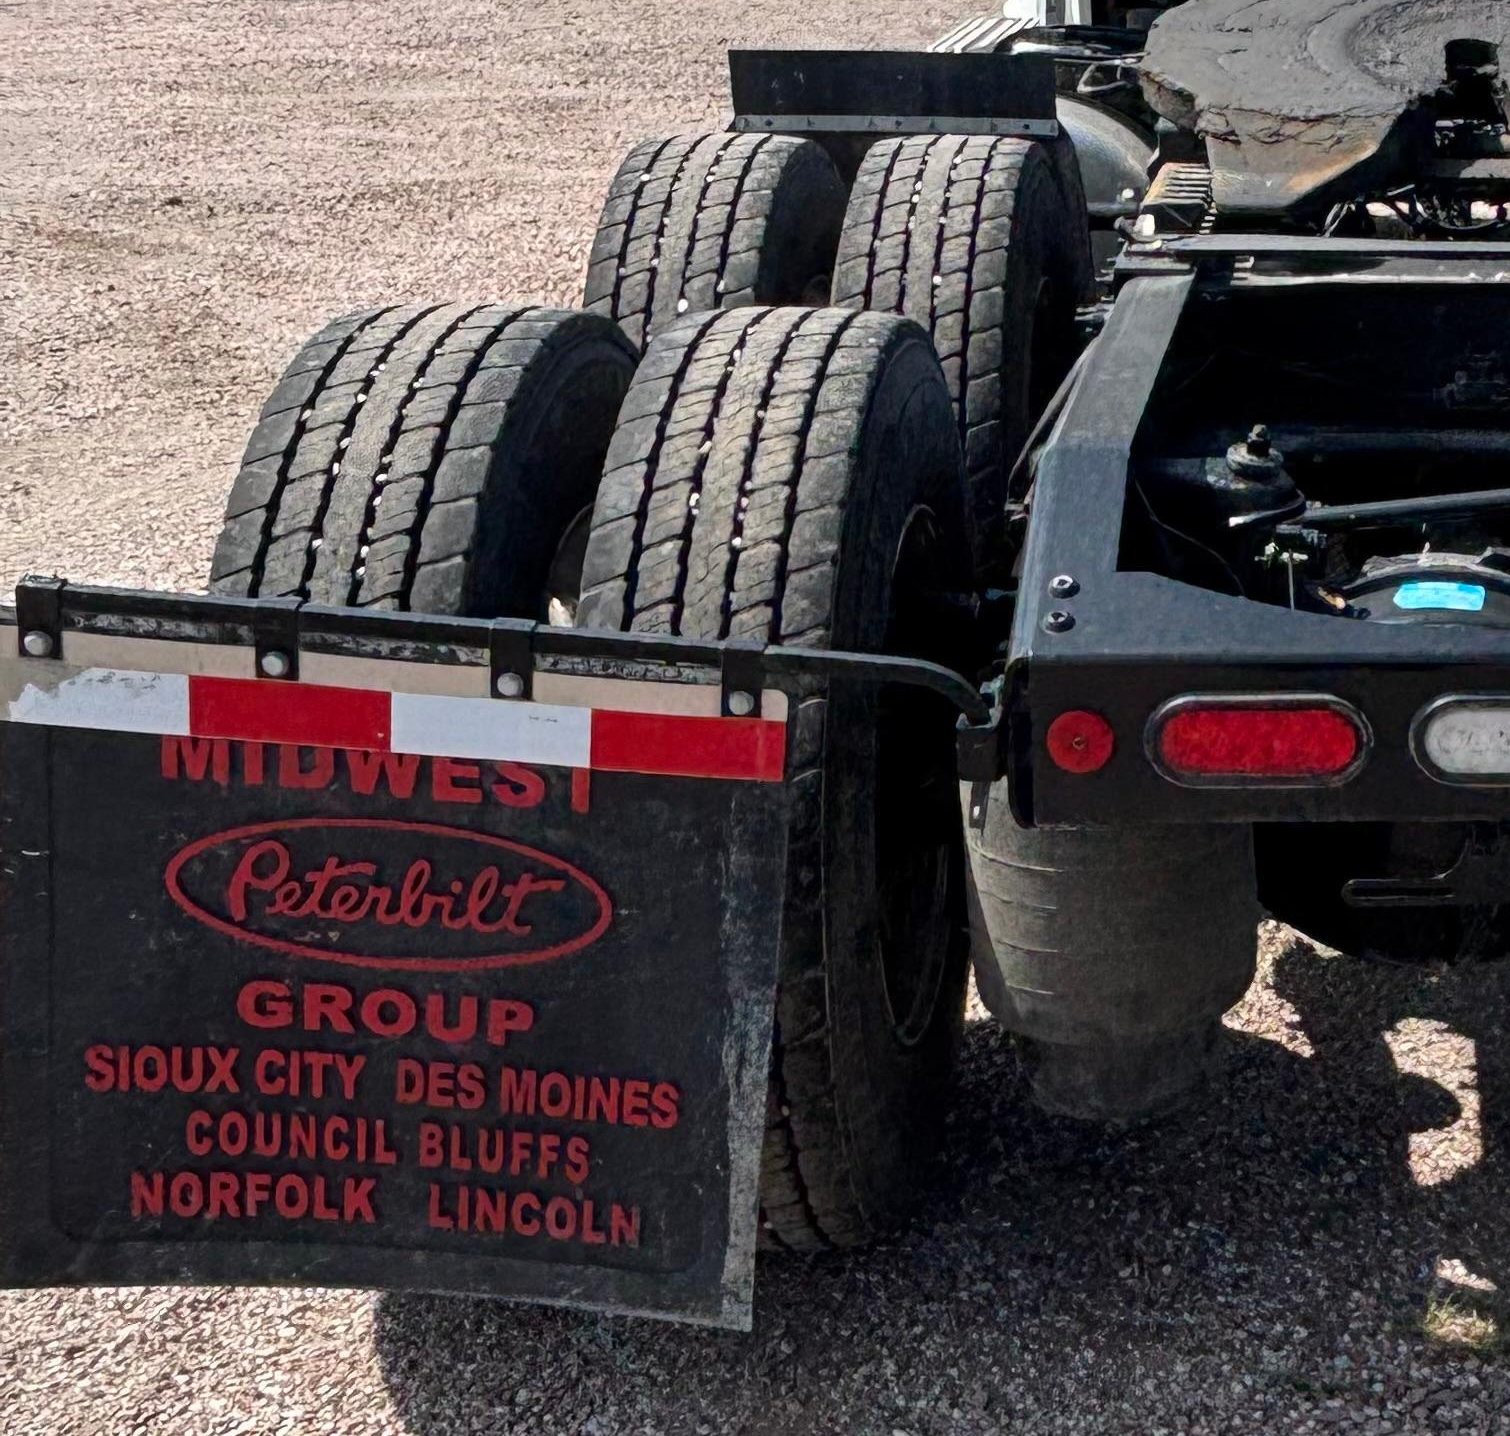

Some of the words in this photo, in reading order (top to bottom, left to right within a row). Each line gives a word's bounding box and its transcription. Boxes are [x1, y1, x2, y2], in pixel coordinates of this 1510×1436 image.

[227, 840, 566, 937] Peterbilt
[236, 980, 533, 1045] GROUP
[85, 1044, 240, 1093] SIOUX
[254, 1048, 366, 1100] CITY
[396, 1059, 486, 1110] DES
[499, 1067, 680, 1129] MOINES
[186, 1110, 397, 1165] COUNCIL
[418, 1120, 591, 1184] BLUFFS
[130, 1172, 376, 1223] NORFOLK
[428, 1183, 640, 1246] LINCOLN
